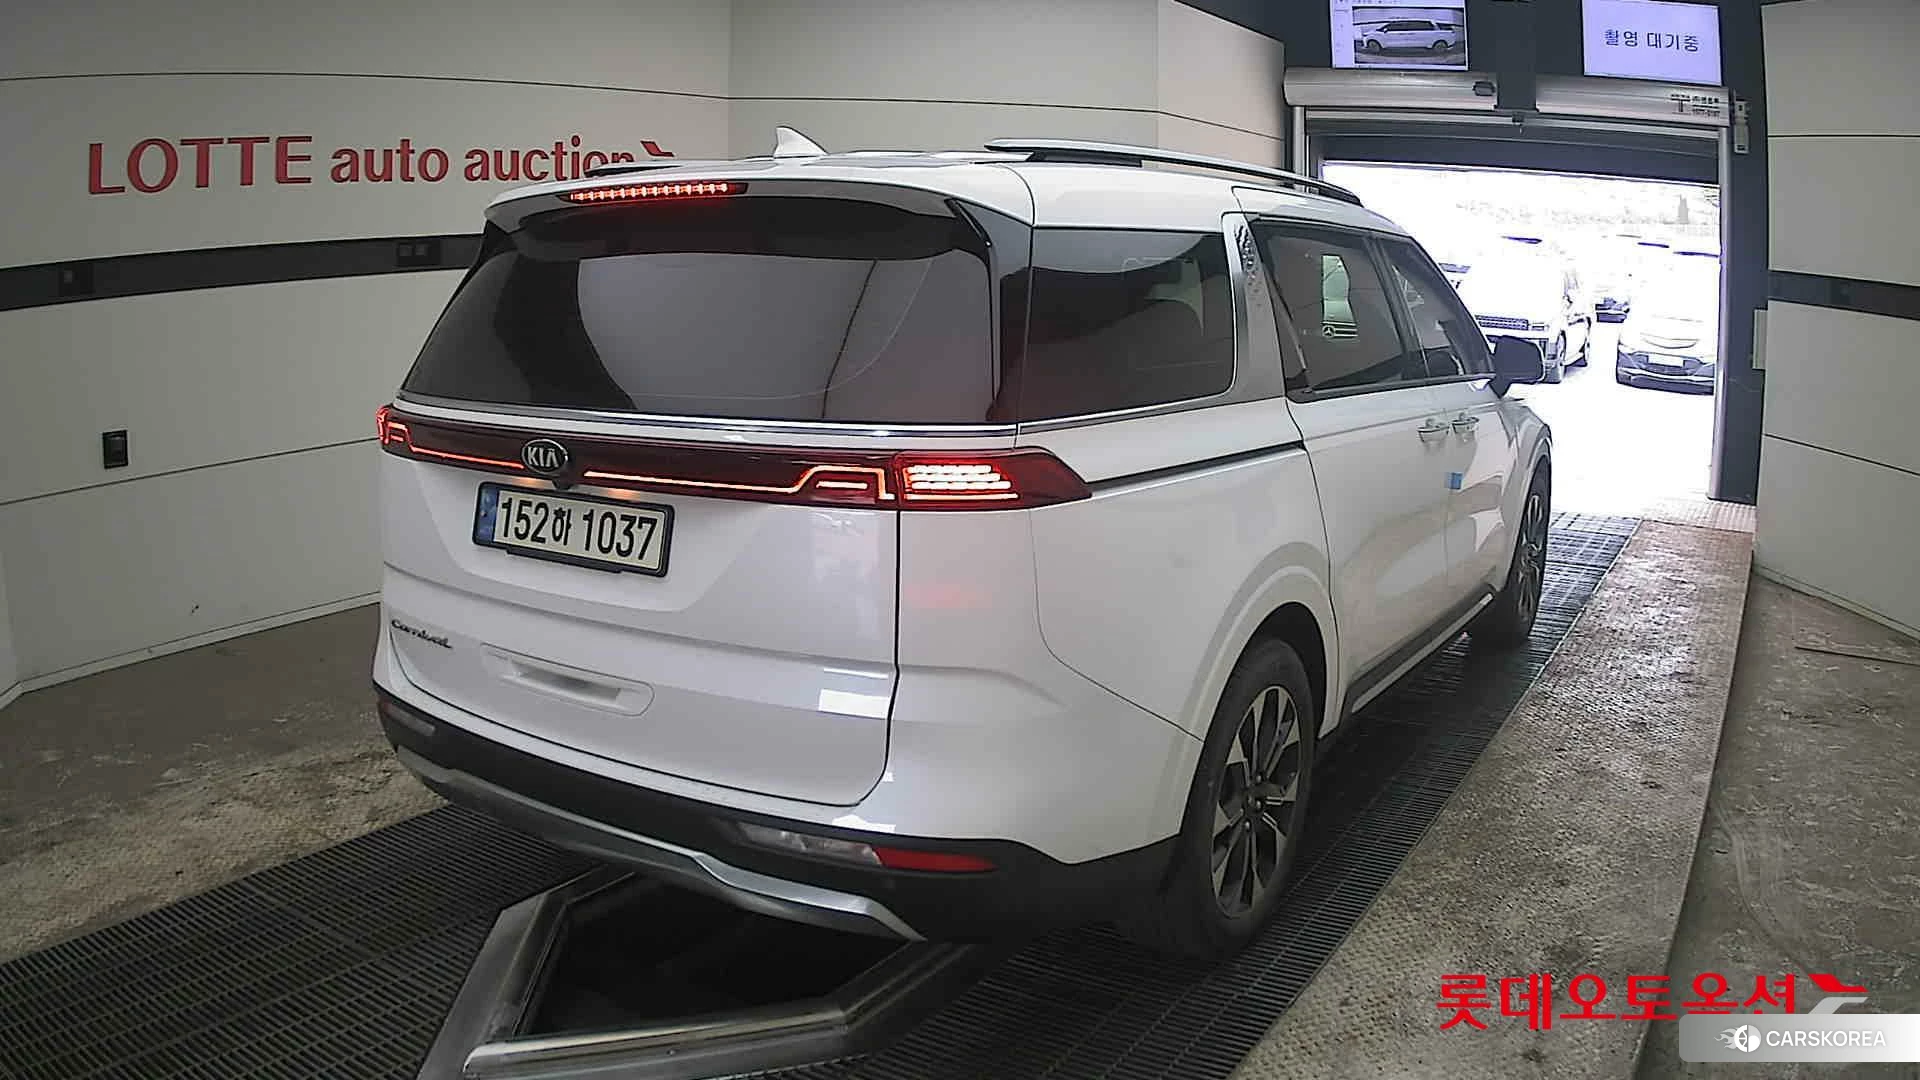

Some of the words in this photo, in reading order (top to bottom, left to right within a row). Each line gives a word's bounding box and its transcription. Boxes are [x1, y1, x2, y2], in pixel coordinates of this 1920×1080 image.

[1604, 29, 1639, 47] 촬영
[1646, 32, 1699, 52] 대기중
[89, 135, 313, 195] LOTTE
[330, 138, 450, 183] auto
[527, 445, 560, 468] KIA
[501, 497, 572, 546] 152하
[582, 508, 658, 560] 1037
